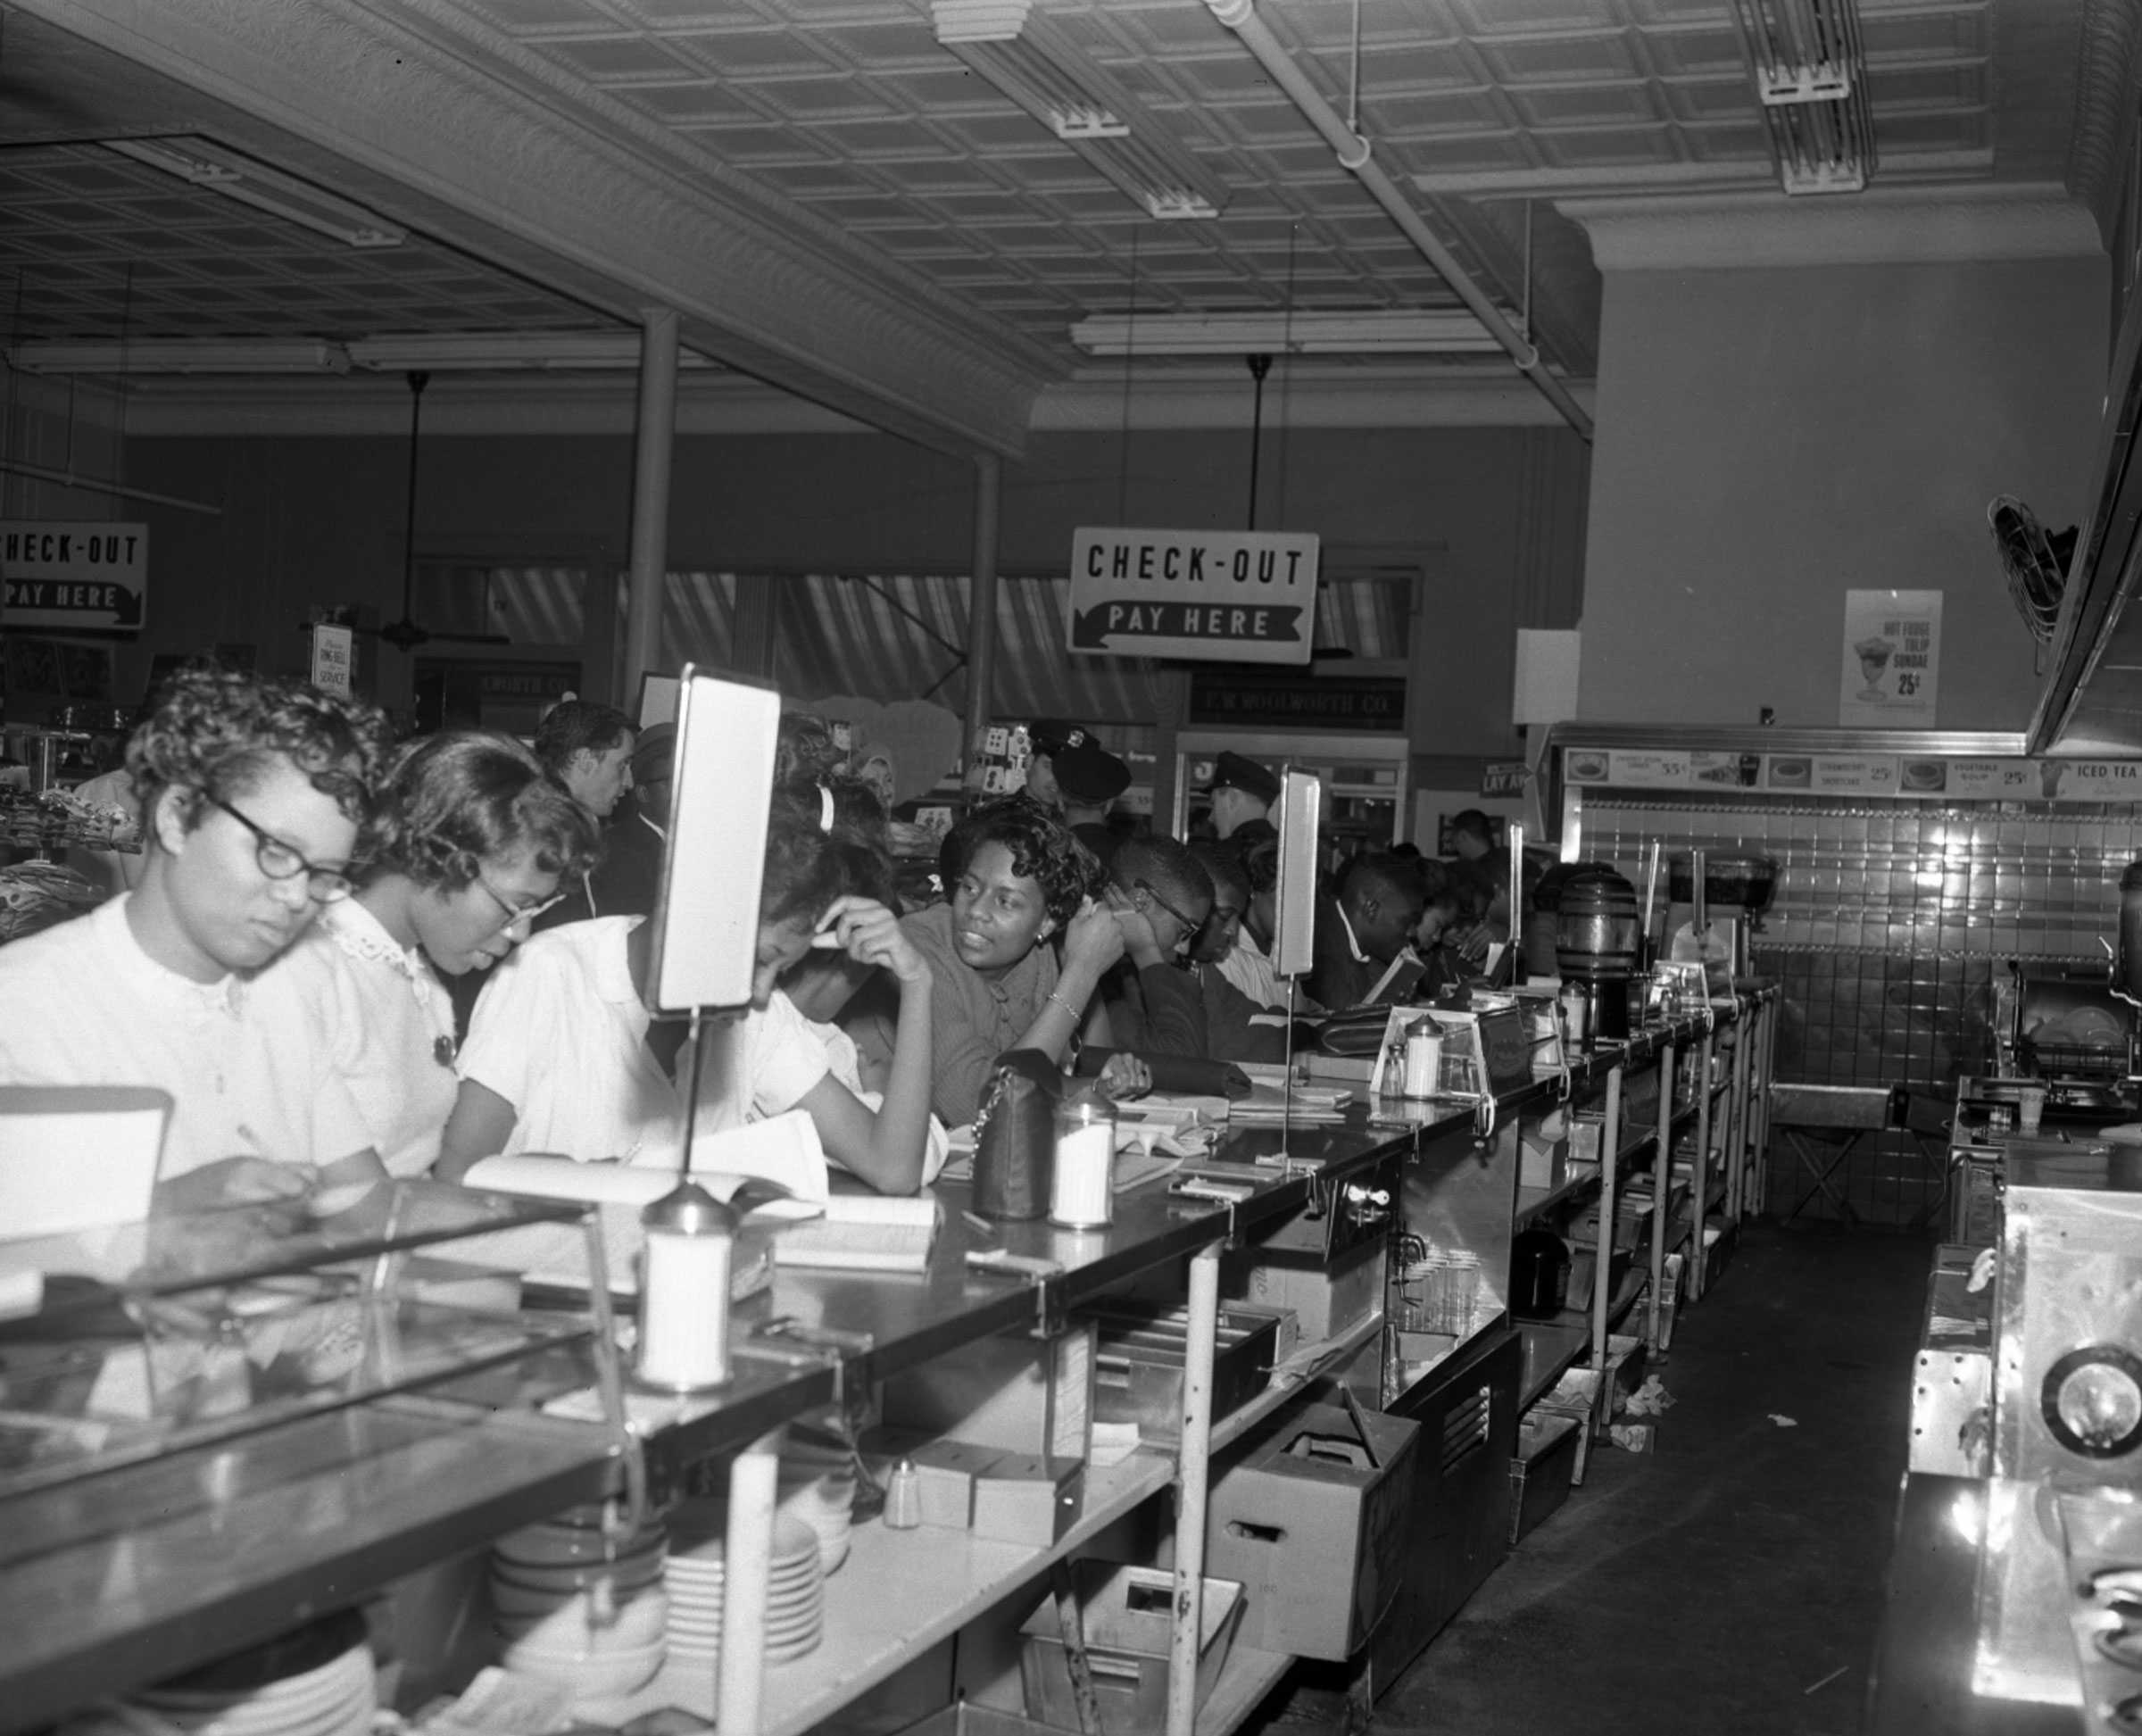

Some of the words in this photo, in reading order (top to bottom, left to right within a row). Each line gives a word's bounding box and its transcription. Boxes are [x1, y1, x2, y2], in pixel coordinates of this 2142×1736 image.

[0, 534, 137, 564] HECK-OUT
[1088, 544, 1302, 585] CHECK-OUT
[4, 584, 44, 604] PAY
[57, 585, 117, 607] HERE
[1108, 605, 1164, 631] PAY
[1183, 608, 1269, 635] HERE
[1884, 621, 1900, 635] HOT
[1903, 621, 1930, 635] FUDGE
[1905, 638, 1930, 652] TULIP
[1893, 654, 1928, 669] SUNDAE
[320, 670, 345, 685] SERVICE
[1241, 692, 1354, 714] WOOLWORTH
[2077, 764, 2107, 778] ICED
[2114, 765, 2137, 779] TEA
